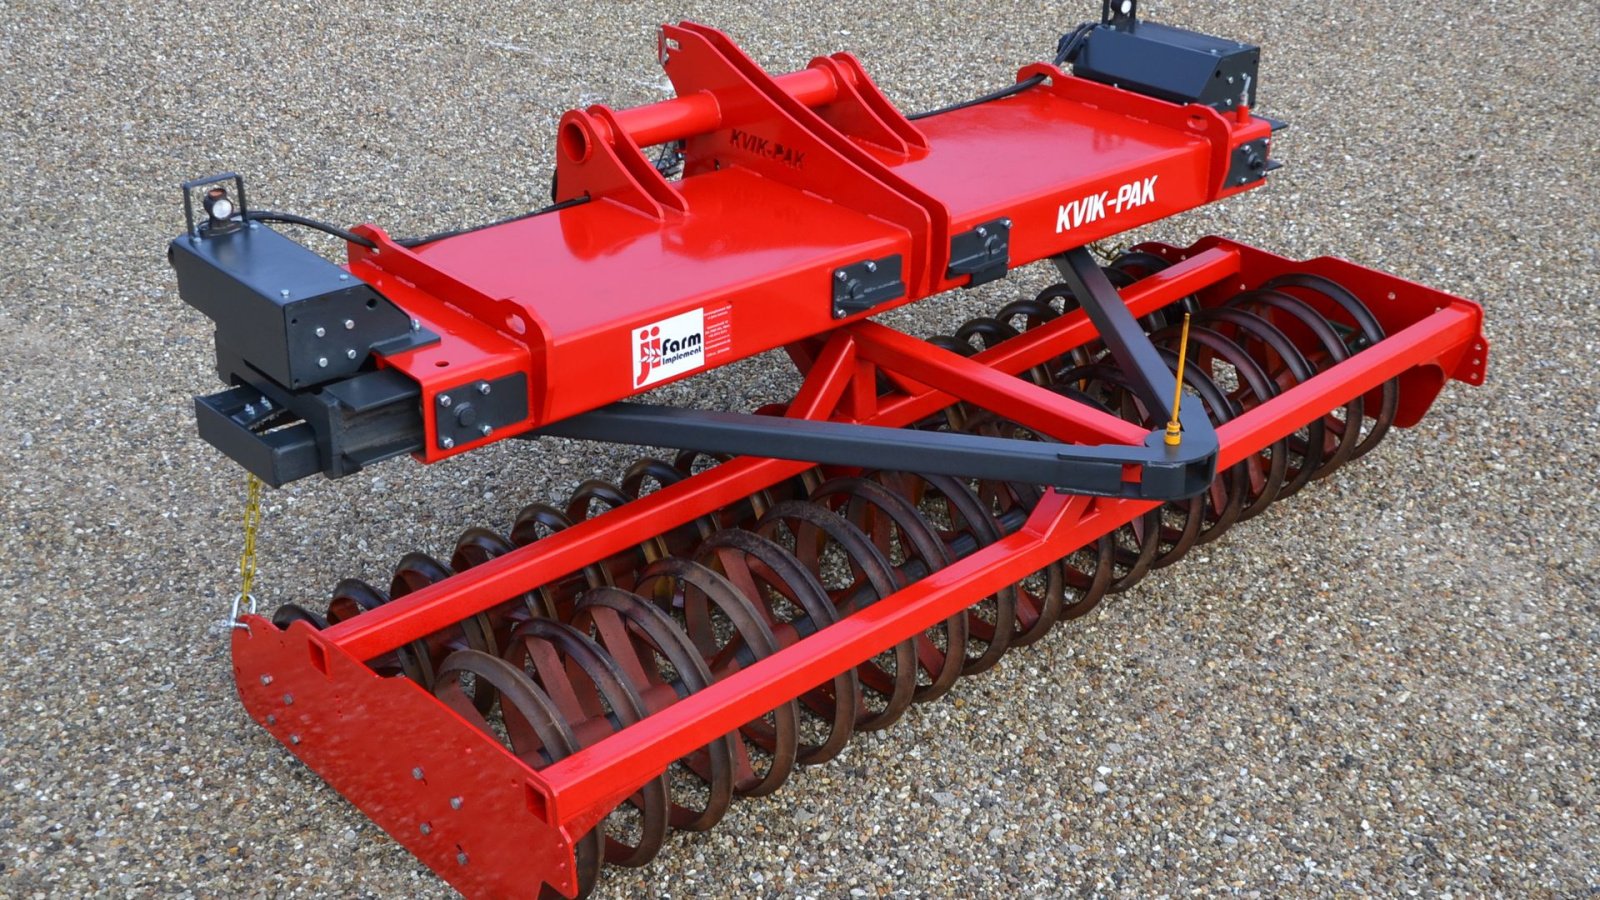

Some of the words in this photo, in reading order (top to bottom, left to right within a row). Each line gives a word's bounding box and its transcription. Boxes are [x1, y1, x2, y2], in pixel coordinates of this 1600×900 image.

[730, 128, 806, 169] KVIK-PAK
[1055, 175, 1158, 233] KVIK-PAK
[662, 332, 702, 356] Farm
